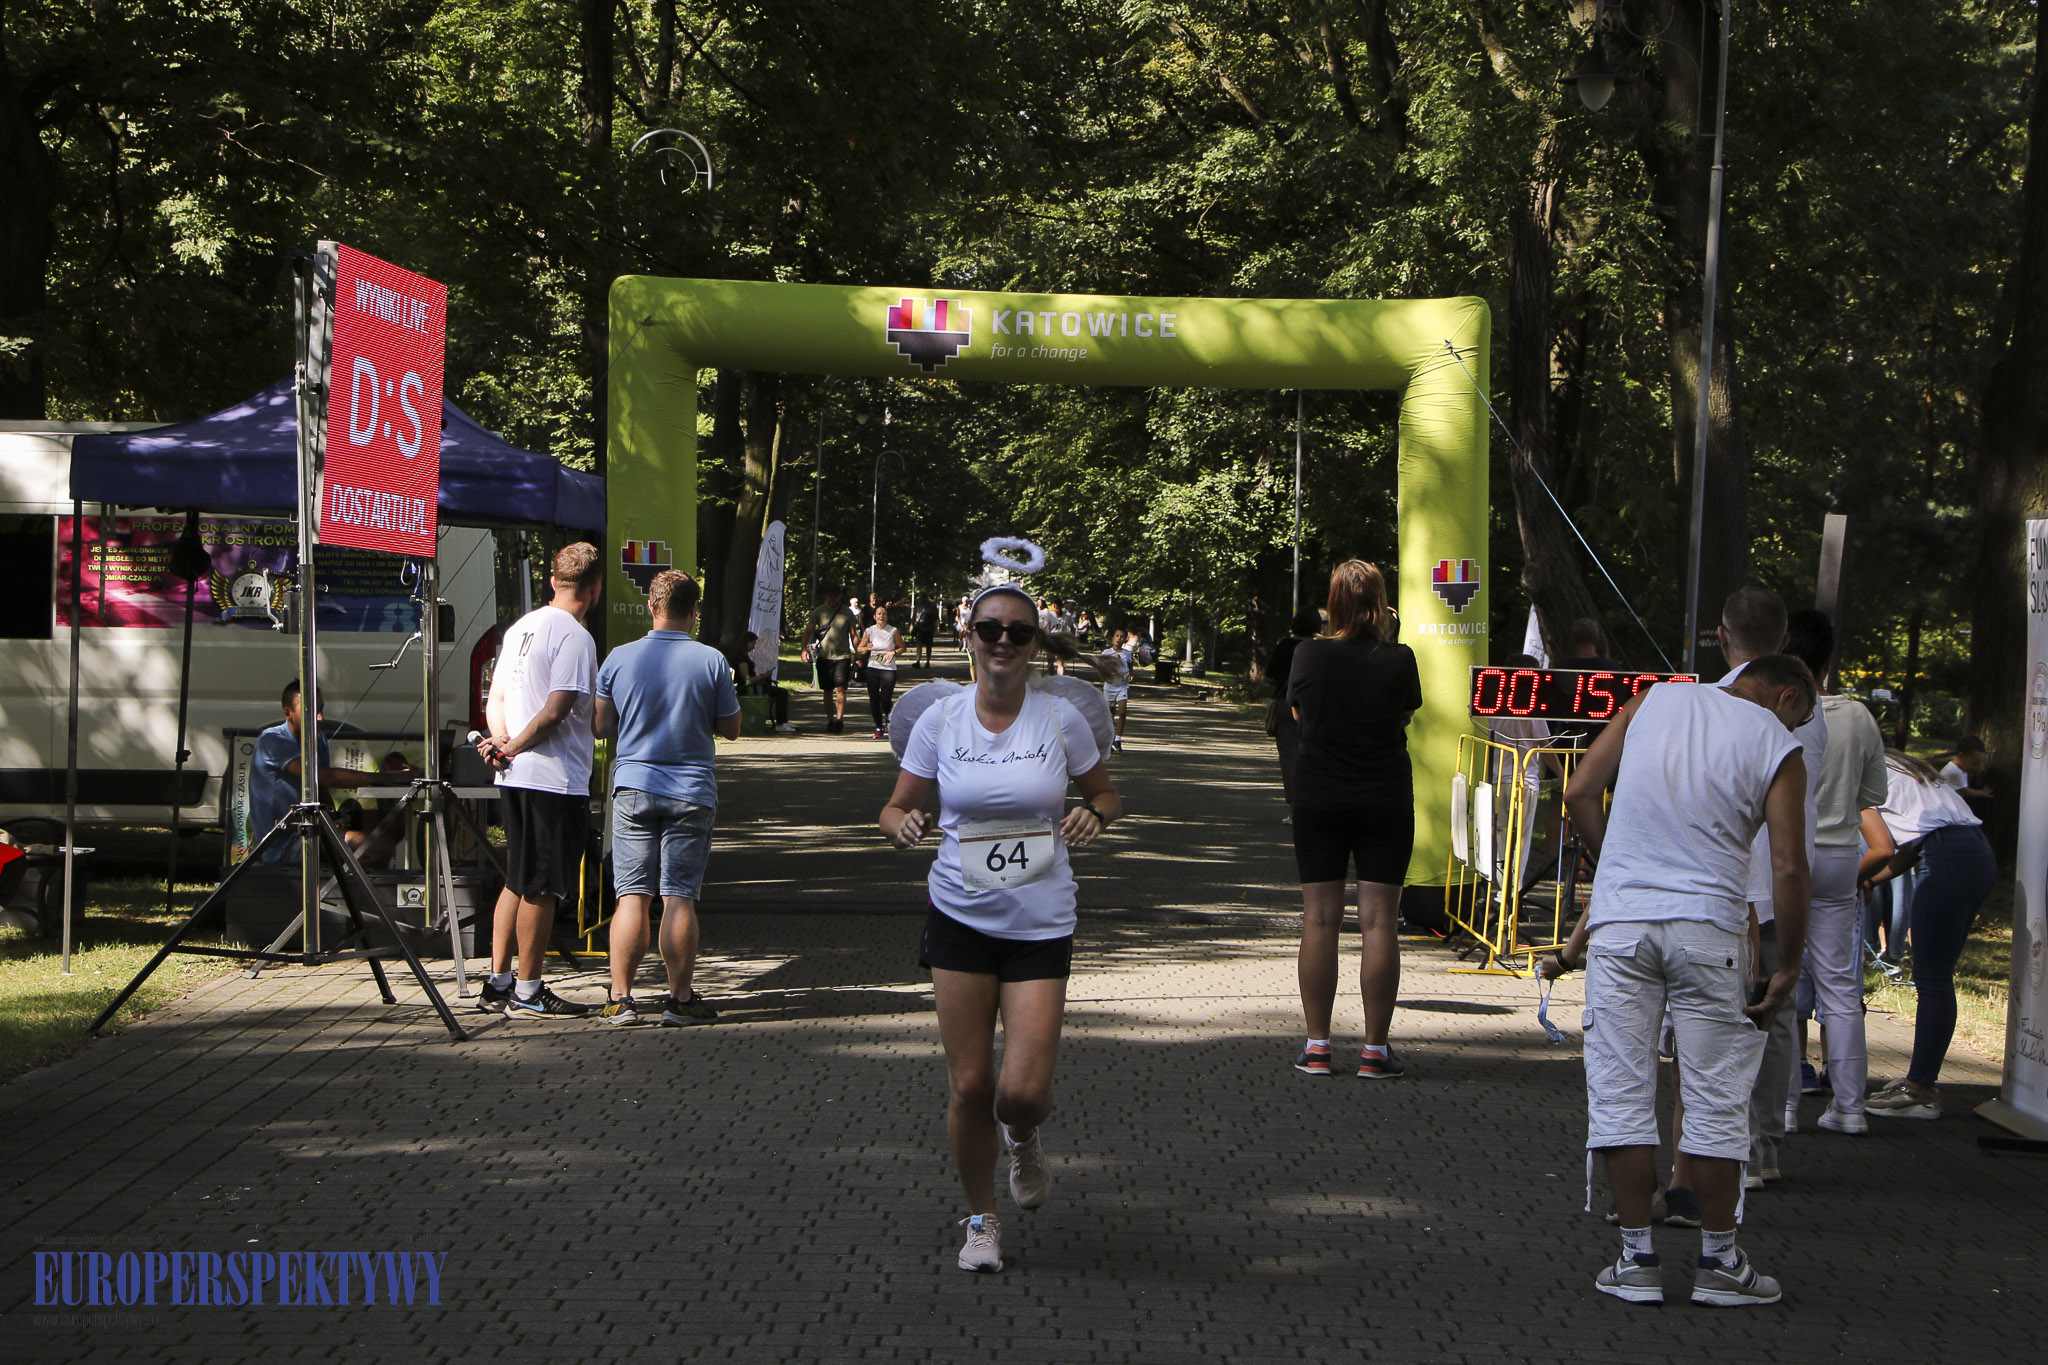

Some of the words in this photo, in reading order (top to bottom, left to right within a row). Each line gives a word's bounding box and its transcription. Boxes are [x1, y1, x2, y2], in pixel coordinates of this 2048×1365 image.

[355, 278, 401, 325] WYNIKI
[402, 295, 430, 335] LIVE
[992, 309, 1177, 338] KATOWICE
[990, 342, 1013, 361] for
[1016, 347, 1026, 358] a
[1030, 344, 1088, 363] change
[349, 356, 424, 459] D:S
[330, 484, 428, 536] DOSTARTU.PL
[240, 586, 264, 598] JKR
[1418, 622, 1488, 636] KATOWICE
[986, 841, 1029, 873] 64
